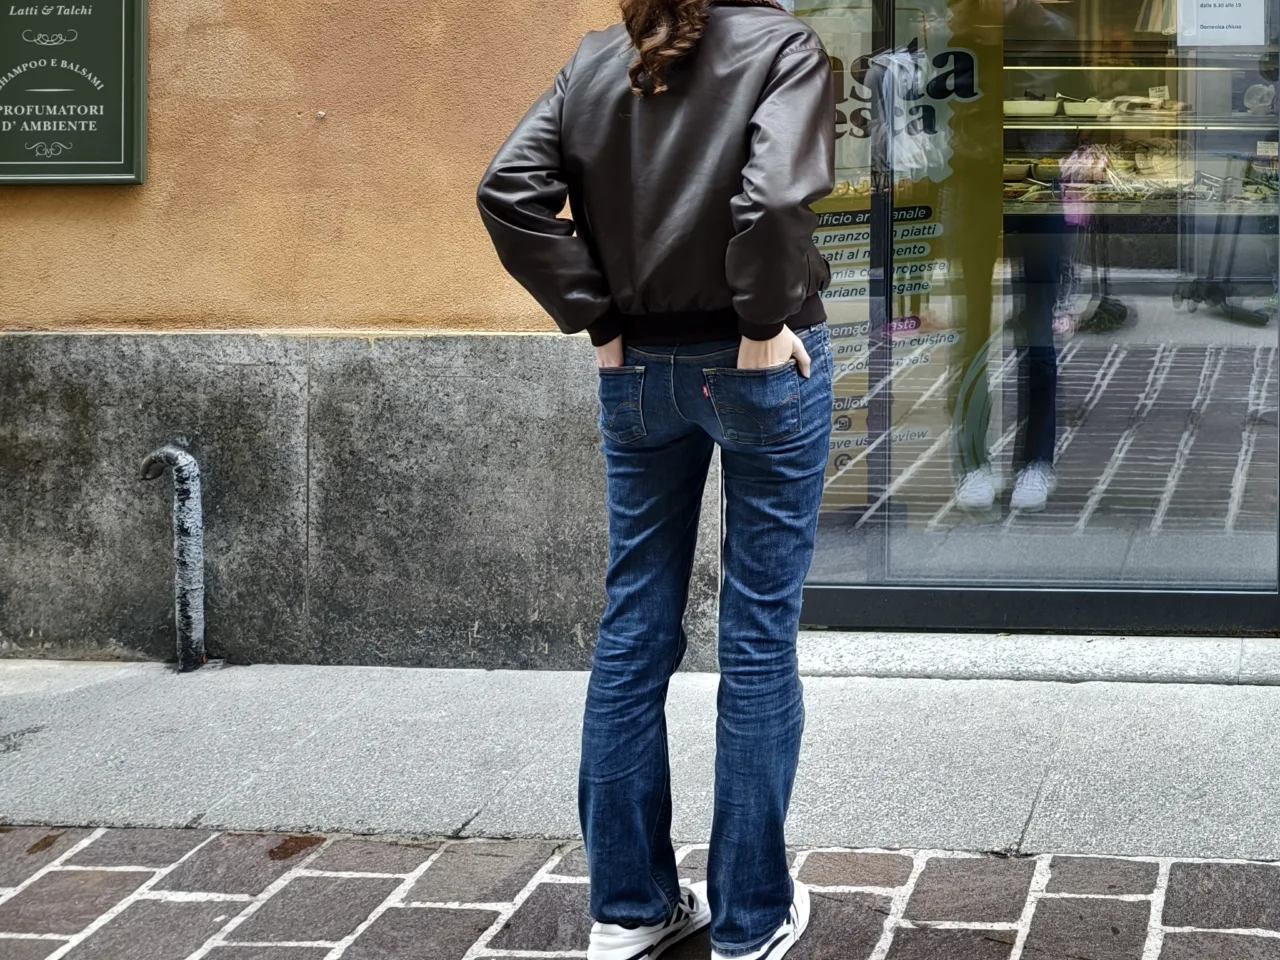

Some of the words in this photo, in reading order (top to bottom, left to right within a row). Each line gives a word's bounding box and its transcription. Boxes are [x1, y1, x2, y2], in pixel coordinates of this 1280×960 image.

[8, 5, 39, 16] Latti
[41, 5, 55, 15] &
[56, 5, 93, 16] Talchi
[50, 58, 58, 67] E
[60, 59, 105, 91] BALSAMI
[20, 120, 98, 132] AMBIENTE
[818, 213, 852, 226] ificio
[823, 231, 870, 246] pranzo
[900, 224, 937, 239] piatti
[846, 248, 860, 261] al
[891, 318, 917, 332] asta
[909, 332, 955, 347] cuisine
[829, 439, 852, 450] ave
[891, 428, 928, 443] eview
